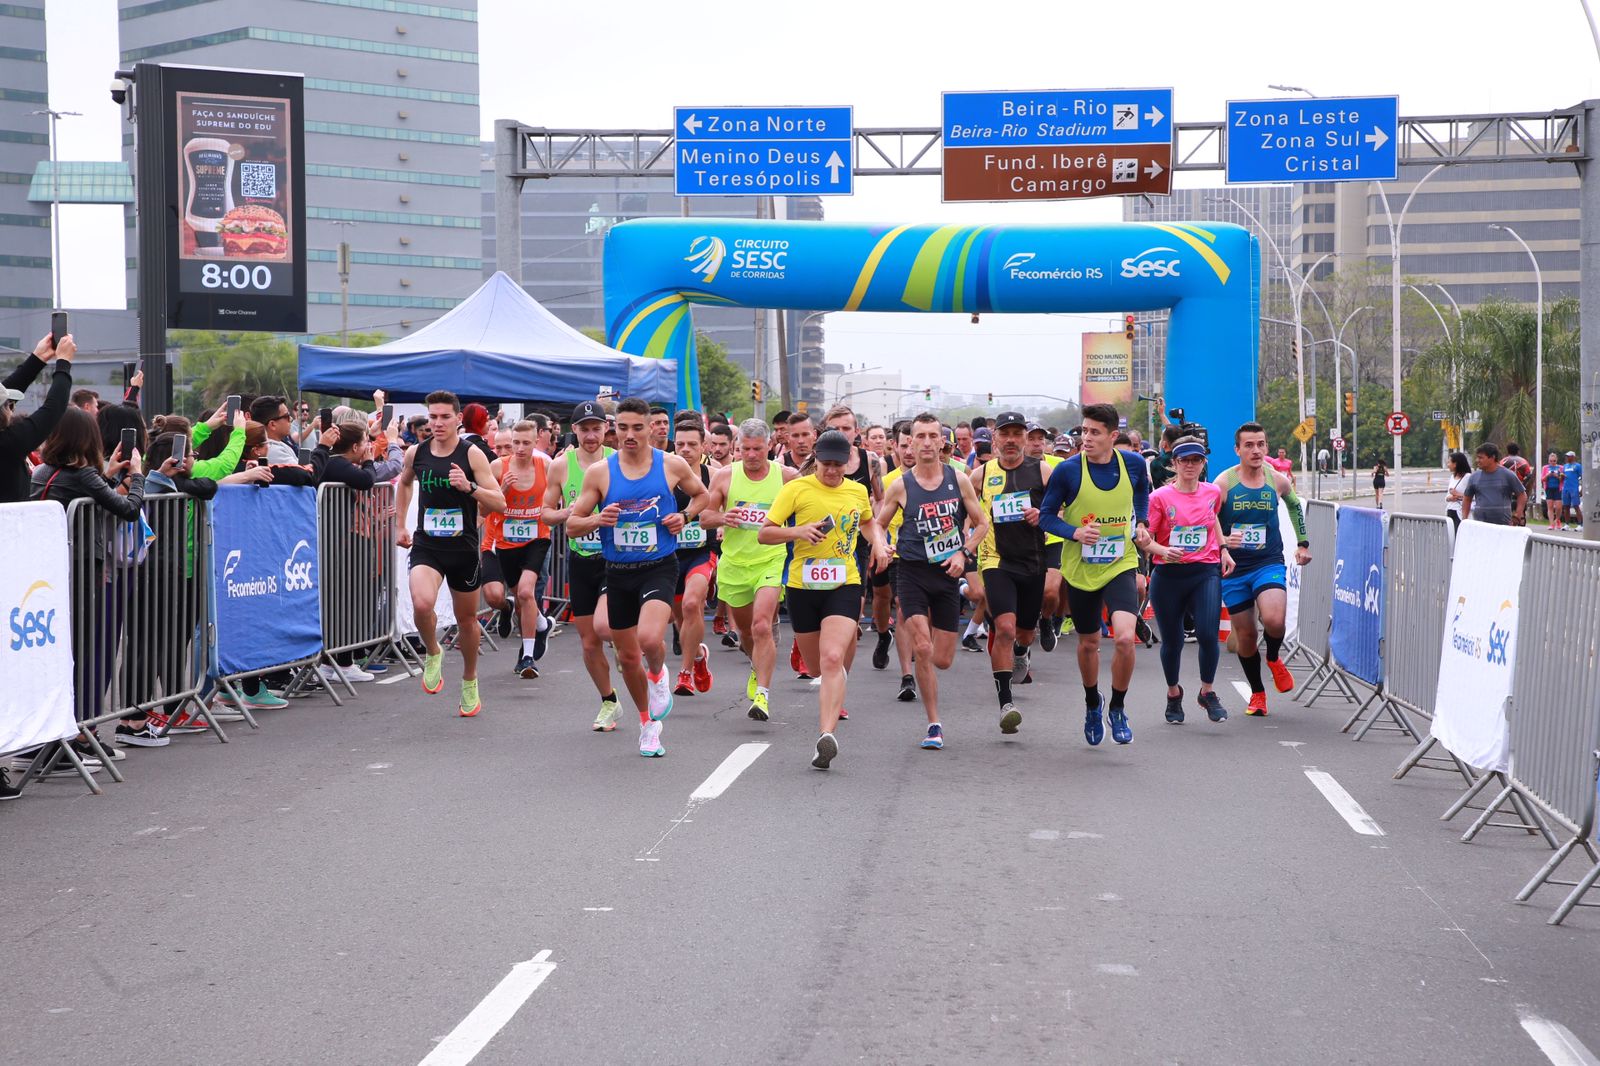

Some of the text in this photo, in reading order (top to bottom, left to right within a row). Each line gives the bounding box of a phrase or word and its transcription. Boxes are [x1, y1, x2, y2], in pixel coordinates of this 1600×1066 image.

[192, 109, 214, 118] FAÇA
[226, 112, 276, 121] SANDUÍCHE
[1002, 100, 1107, 117] Beira-Rio
[196, 120, 236, 129] SUPREME
[708, 116, 827, 132] Zona Norte
[1234, 109, 1360, 127] Zona Leste
[951, 123, 1107, 138] Beira-Rio Stadium
[1261, 131, 1360, 149] Zona Sul
[682, 149, 820, 164] Menino Deus
[985, 153, 1107, 170] Fund. Iberê
[1285, 155, 1360, 172] Cristal
[694, 170, 820, 189] Teresópolis
[1011, 177, 1106, 193] Camargo
[734, 239, 789, 250] CIRCUITO
[731, 251, 788, 270] SESC
[1120, 255, 1181, 278] Sesc
[201, 263, 272, 290] 8:00
[742, 271, 785, 279] CORRIDAS
[1010, 266, 1103, 280] Fecomércio RS
[1086, 367, 1129, 375] ANUNCIE:
[1000, 500, 1023, 514] 115
[1233, 501, 1274, 510] BRASIL
[432, 516, 456, 529] 144
[741, 510, 766, 523] 652
[1095, 515, 1127, 524] ALPHA
[510, 526, 530, 537] 161
[622, 531, 649, 544] 178
[679, 529, 700, 541] 169
[1177, 533, 1200, 544] 165
[1244, 531, 1260, 542] 33
[929, 536, 960, 554] 1044
[1091, 543, 1116, 556] 174
[284, 554, 313, 592] Sesc
[811, 567, 837, 581] 661
[227, 575, 278, 598] Fecomércio RS
[10, 606, 55, 651] Sesc
[1487, 619, 1510, 666] Sesc
